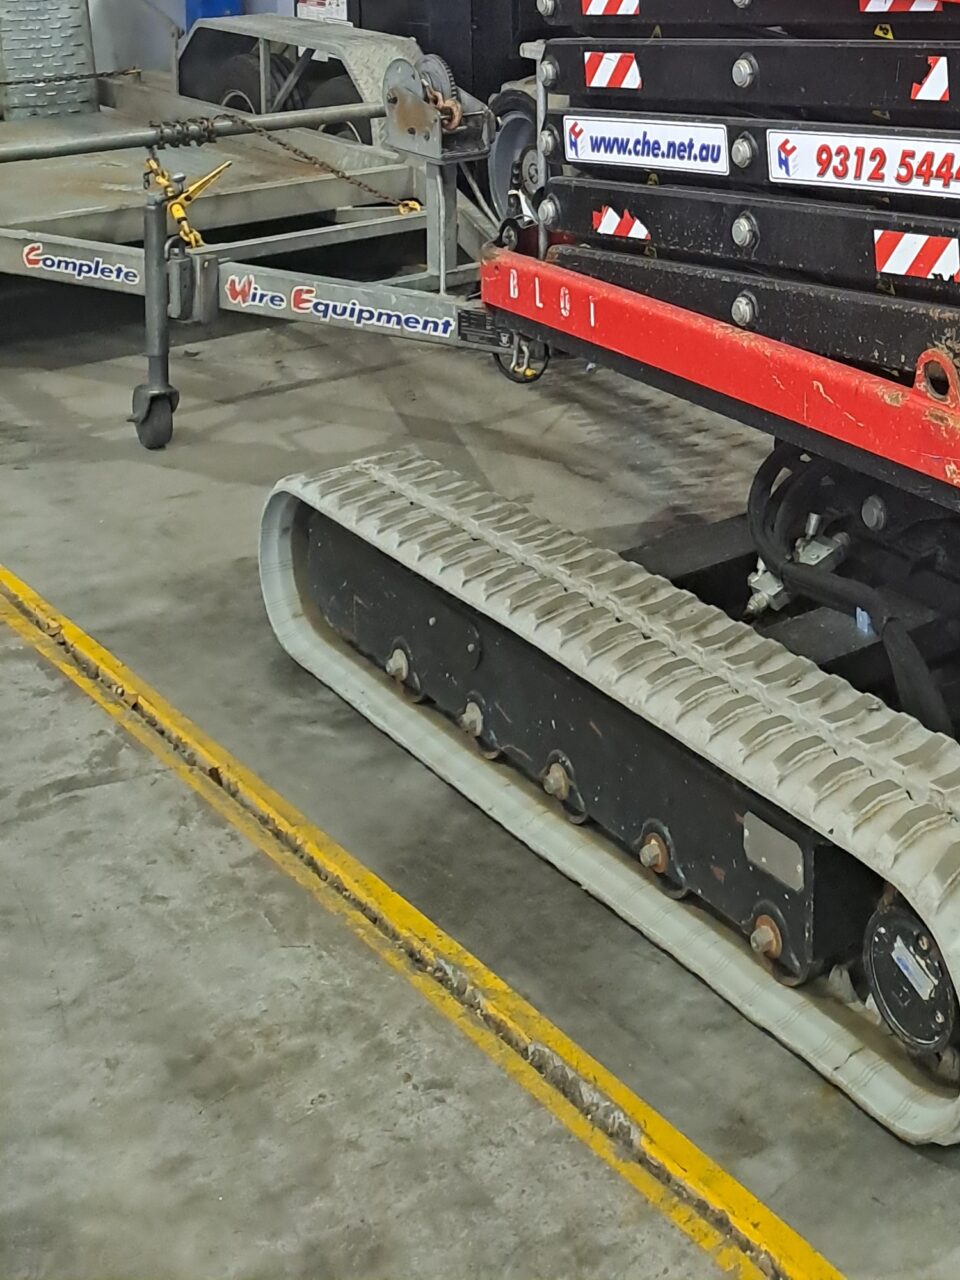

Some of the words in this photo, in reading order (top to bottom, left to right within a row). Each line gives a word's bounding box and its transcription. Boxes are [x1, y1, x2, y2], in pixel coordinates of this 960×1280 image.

[589, 131, 722, 165] www.che.net.au
[815, 144, 887, 182] 9312
[24, 244, 139, 283] Complete
[292, 287, 455, 336] Equipment
